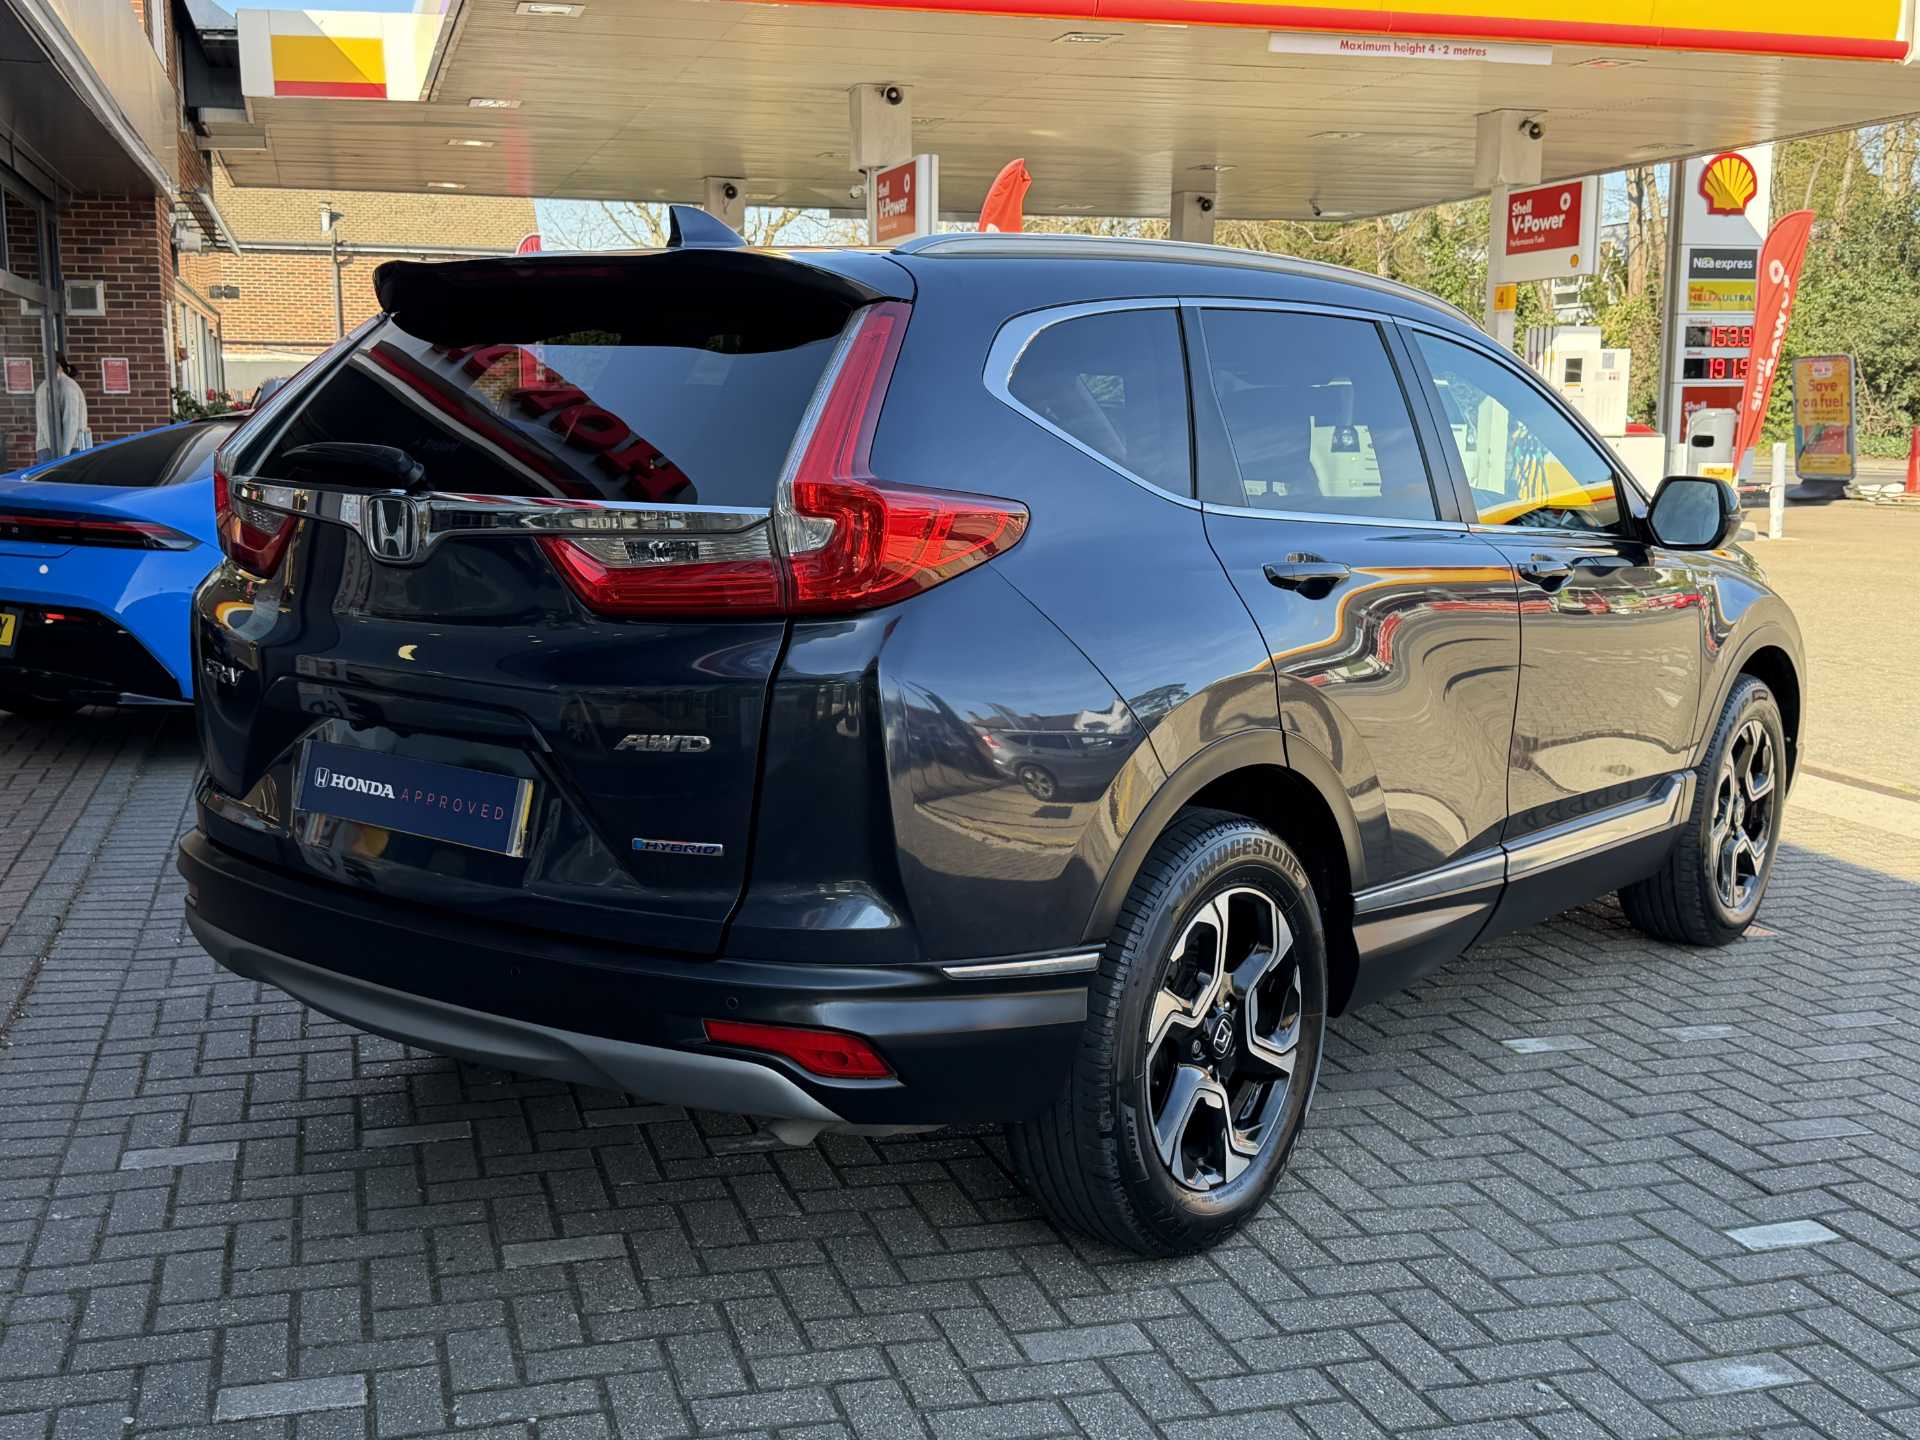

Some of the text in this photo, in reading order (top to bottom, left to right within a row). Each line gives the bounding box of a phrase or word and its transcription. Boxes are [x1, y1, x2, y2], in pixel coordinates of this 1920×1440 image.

[1340, 40, 1391, 53] Maximum
[1394, 41, 1427, 56] height
[1453, 47, 1487, 57] metres
[1512, 199, 1532, 216] Shell
[1512, 214, 1566, 235] V-Power
[1715, 259, 1753, 271] express
[1497, 291, 1505, 306] 4
[1722, 294, 1753, 303] ULTRA
[1751, 357, 1767, 411] Shell
[1808, 380, 1838, 392] Save
[1802, 393, 1844, 408] on fuel
[613, 734, 711, 752] AWD
[330, 773, 505, 821] HONDA APPROVED
[644, 841, 717, 855] HYBRID
